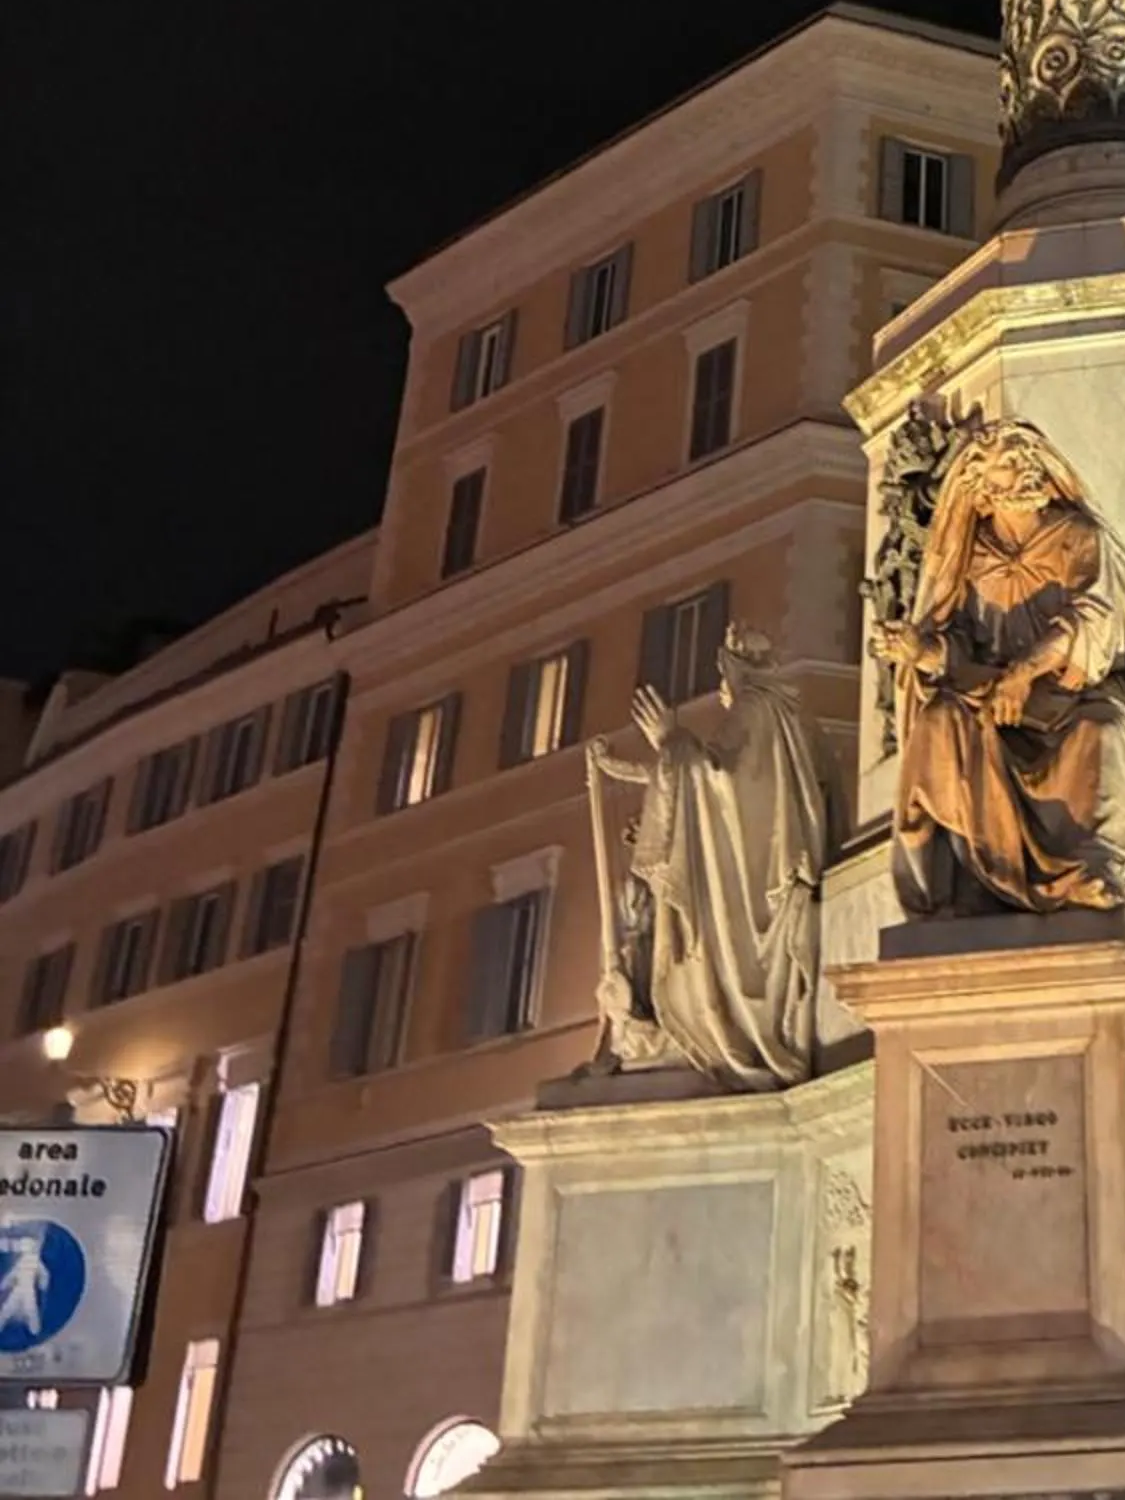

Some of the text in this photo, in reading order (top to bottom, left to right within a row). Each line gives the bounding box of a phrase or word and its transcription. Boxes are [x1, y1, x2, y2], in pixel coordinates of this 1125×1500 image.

[1002, 1109, 1058, 1128] VIRGO
[19, 1142, 78, 1161] area
[0, 1170, 107, 1198] edonale
